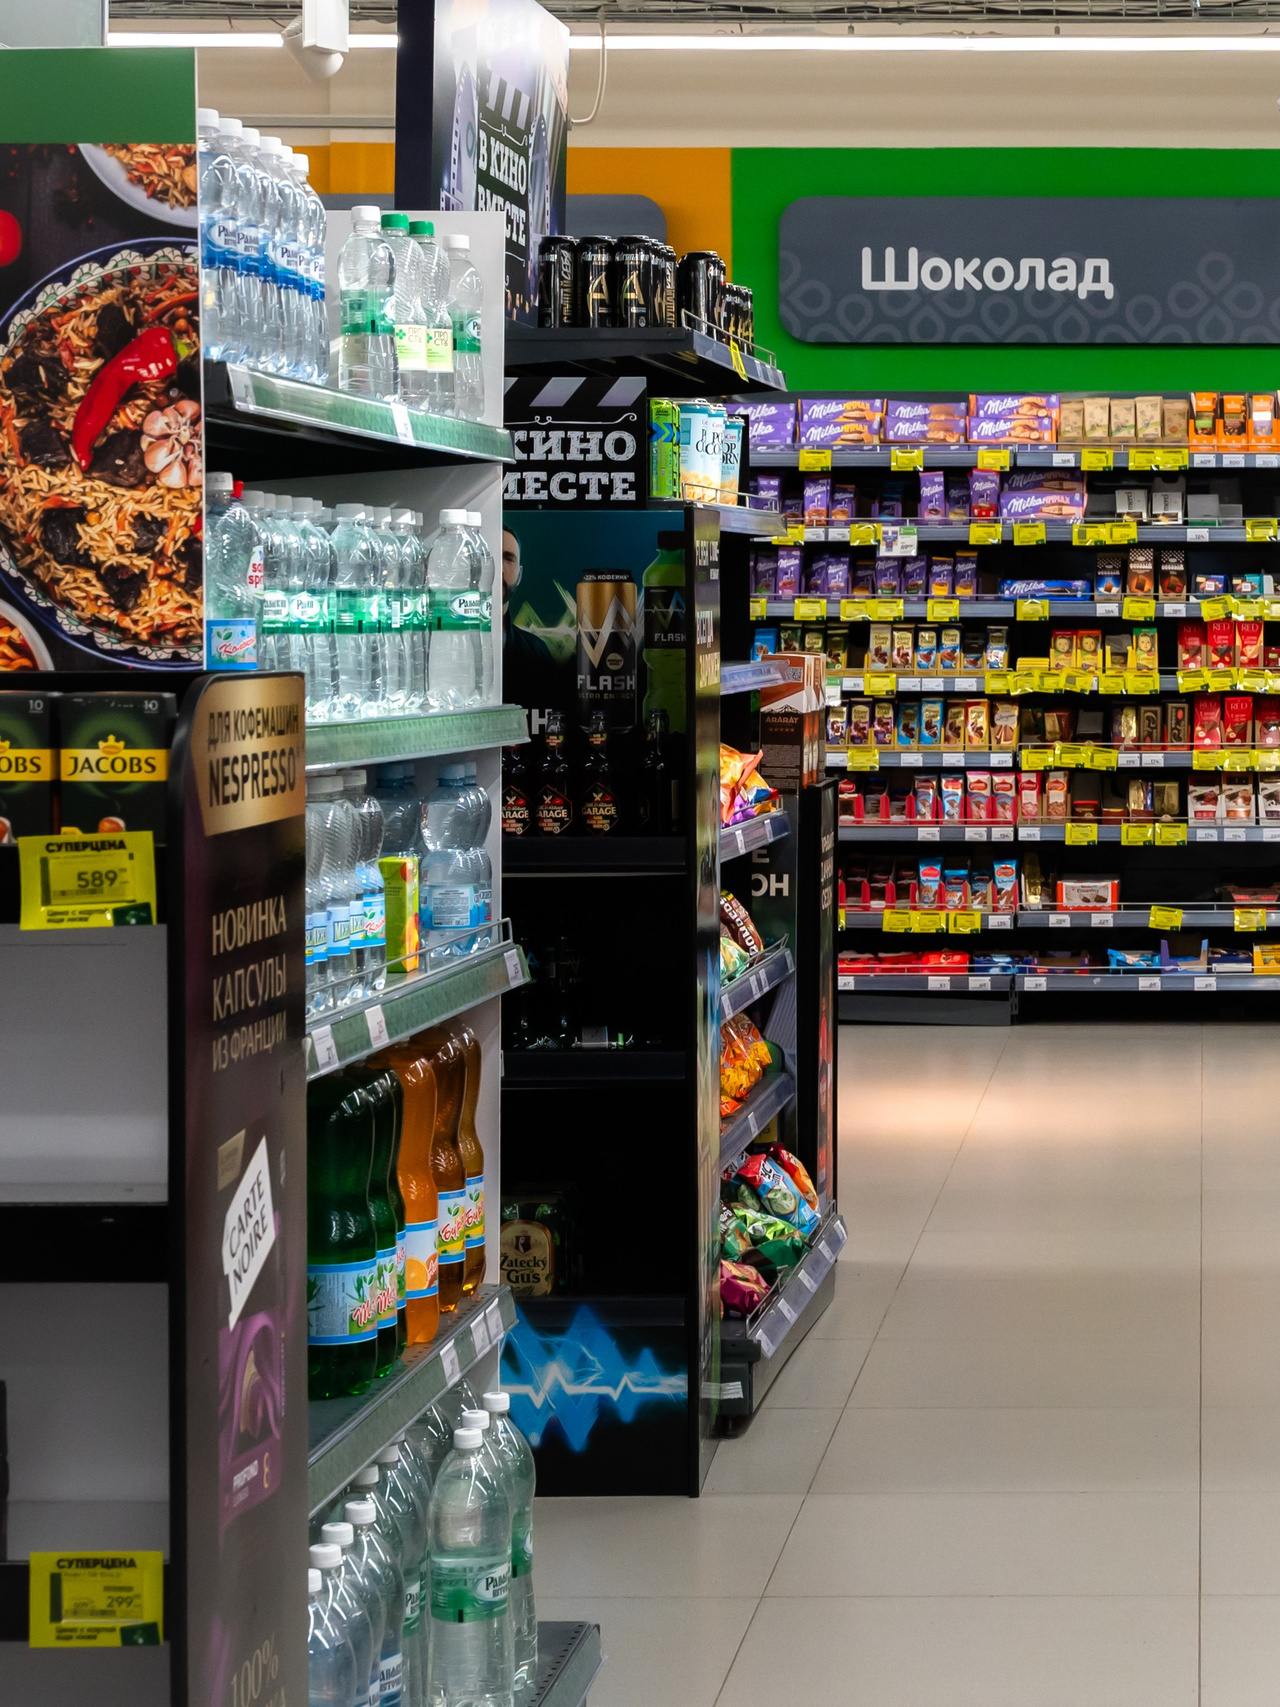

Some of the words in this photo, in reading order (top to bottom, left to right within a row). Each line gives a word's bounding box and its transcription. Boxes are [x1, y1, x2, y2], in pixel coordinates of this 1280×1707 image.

[478, 128, 488, 171] В
[490, 136, 527, 195] КИНО
[861, 246, 1114, 300] Шоколад
[808, 401, 845, 419] Milka
[895, 404, 930, 419] Milka
[984, 395, 1021, 415] Milka
[805, 423, 843, 442] Milka
[893, 421, 929, 437] Milka
[977, 418, 1013, 436] Milka
[920, 485, 944, 497] Milka
[1007, 495, 1044, 514] Milka
[1009, 581, 1046, 595] Milka
[654, 632, 687, 642] FLASH
[577, 674, 635, 690] FLASH
[207, 709, 231, 746] ДЛЯ
[233, 704, 300, 741] КОФЕМАШИН
[66, 756, 157, 776] JACOBS
[207, 747, 296, 808] NESPRESSO
[45, 840, 127, 854] СУПЕРЦЕНА
[76, 869, 119, 889] 589
[211, 894, 288, 957] НОВИНКА
[212, 953, 287, 1022] КАПСУЛЫ
[212, 1037, 230, 1073] ИЗ
[231, 1010, 287, 1064] ФРАНЦИИ
[229, 1170, 266, 1259] CARTE
[231, 1207, 270, 1295] NOIRE
[505, 1268, 542, 1285] Gus
[55, 1557, 137, 1570] СУПЕРЦЕНА
[106, 1596, 134, 1609] 299
